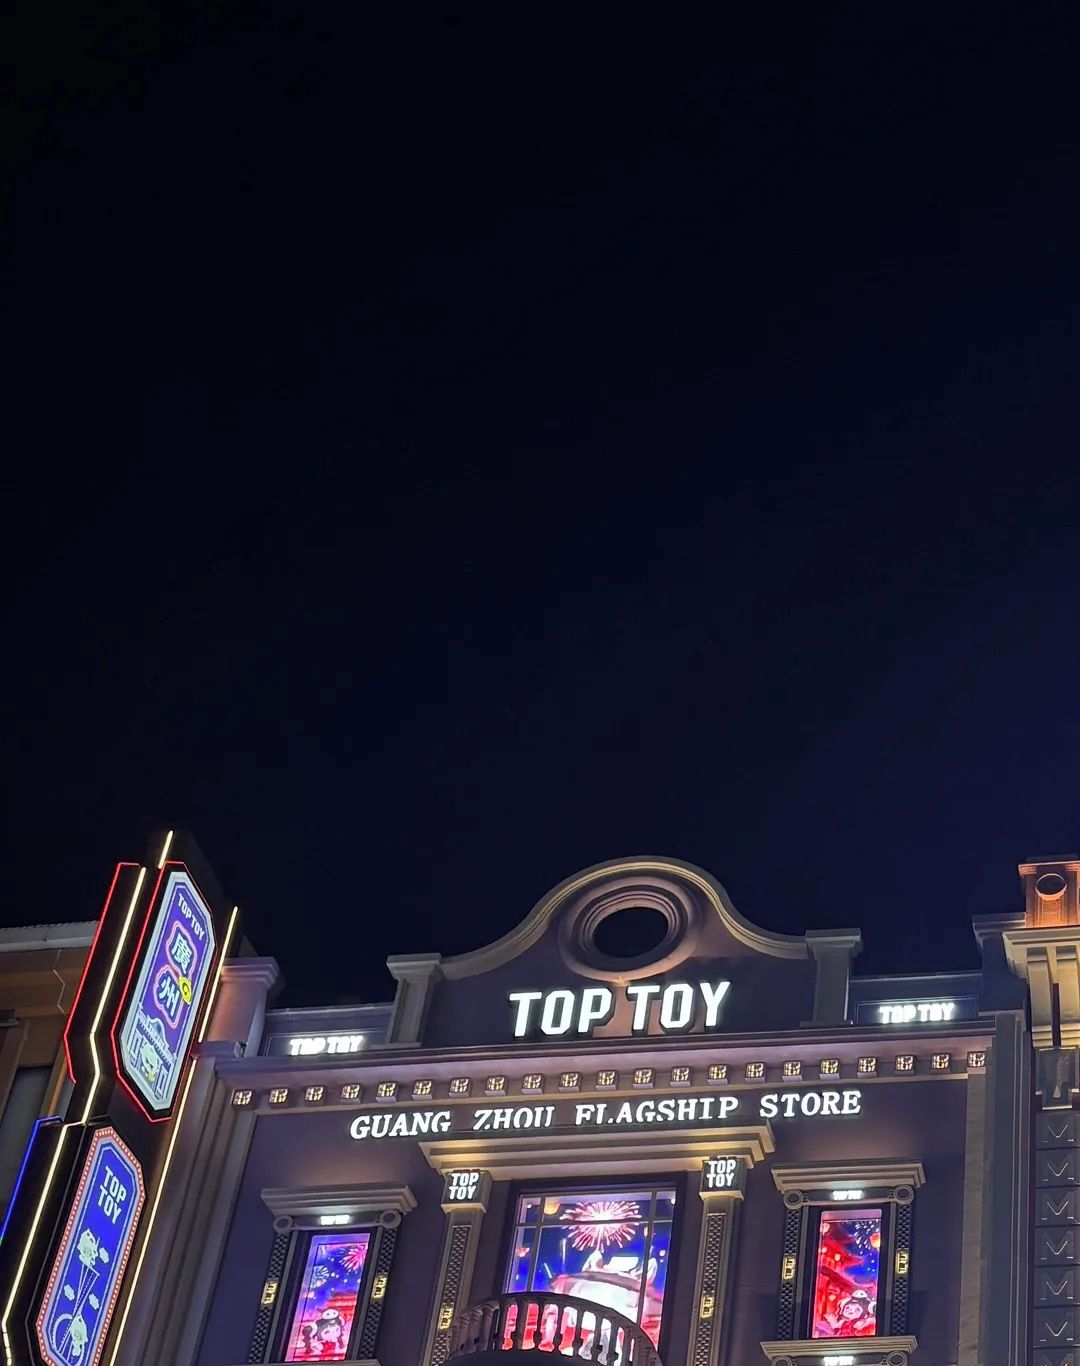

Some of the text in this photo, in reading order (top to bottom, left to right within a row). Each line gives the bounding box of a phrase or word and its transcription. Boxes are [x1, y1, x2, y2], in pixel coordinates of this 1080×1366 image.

[178, 893, 205, 941] TOP TOY
[159, 933, 192, 1017] 廣州
[509, 981, 730, 1037] TOP TOY
[350, 1110, 451, 1140] GUANG
[759, 1091, 862, 1119] STORE
[104, 1166, 127, 1202] TOP
[451, 1172, 479, 1186] TOP
[707, 1174, 735, 1188] TOY
[709, 1160, 736, 1174] TOP
[98, 1185, 122, 1224] TOY
[449, 1186, 477, 1200] TOY
